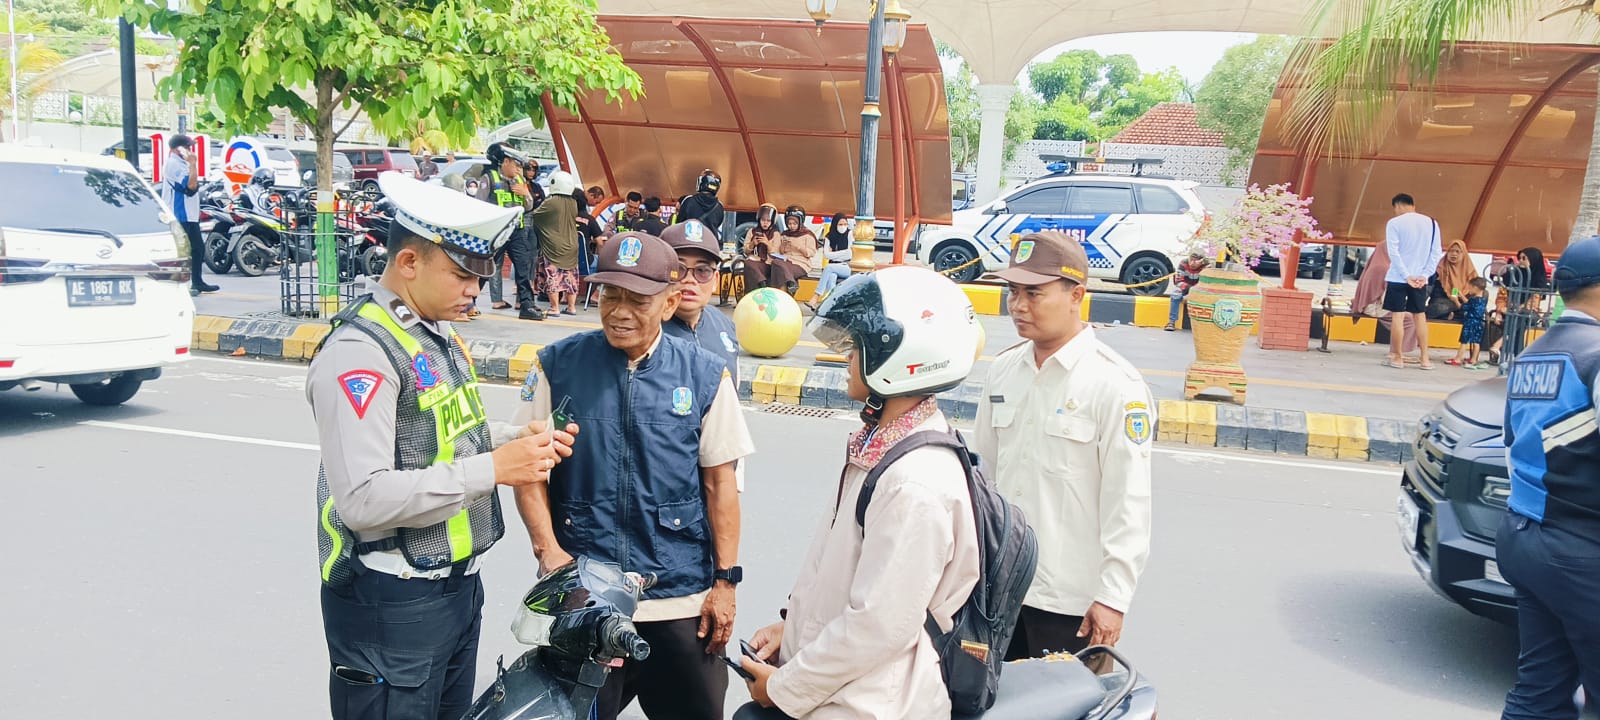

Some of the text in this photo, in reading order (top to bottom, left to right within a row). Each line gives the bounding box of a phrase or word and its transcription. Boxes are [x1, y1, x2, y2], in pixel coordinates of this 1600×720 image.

[1040, 228, 1087, 243] ISI
[72, 280, 133, 296] AE 1867 RK
[1511, 363, 1560, 395] DISHUB
